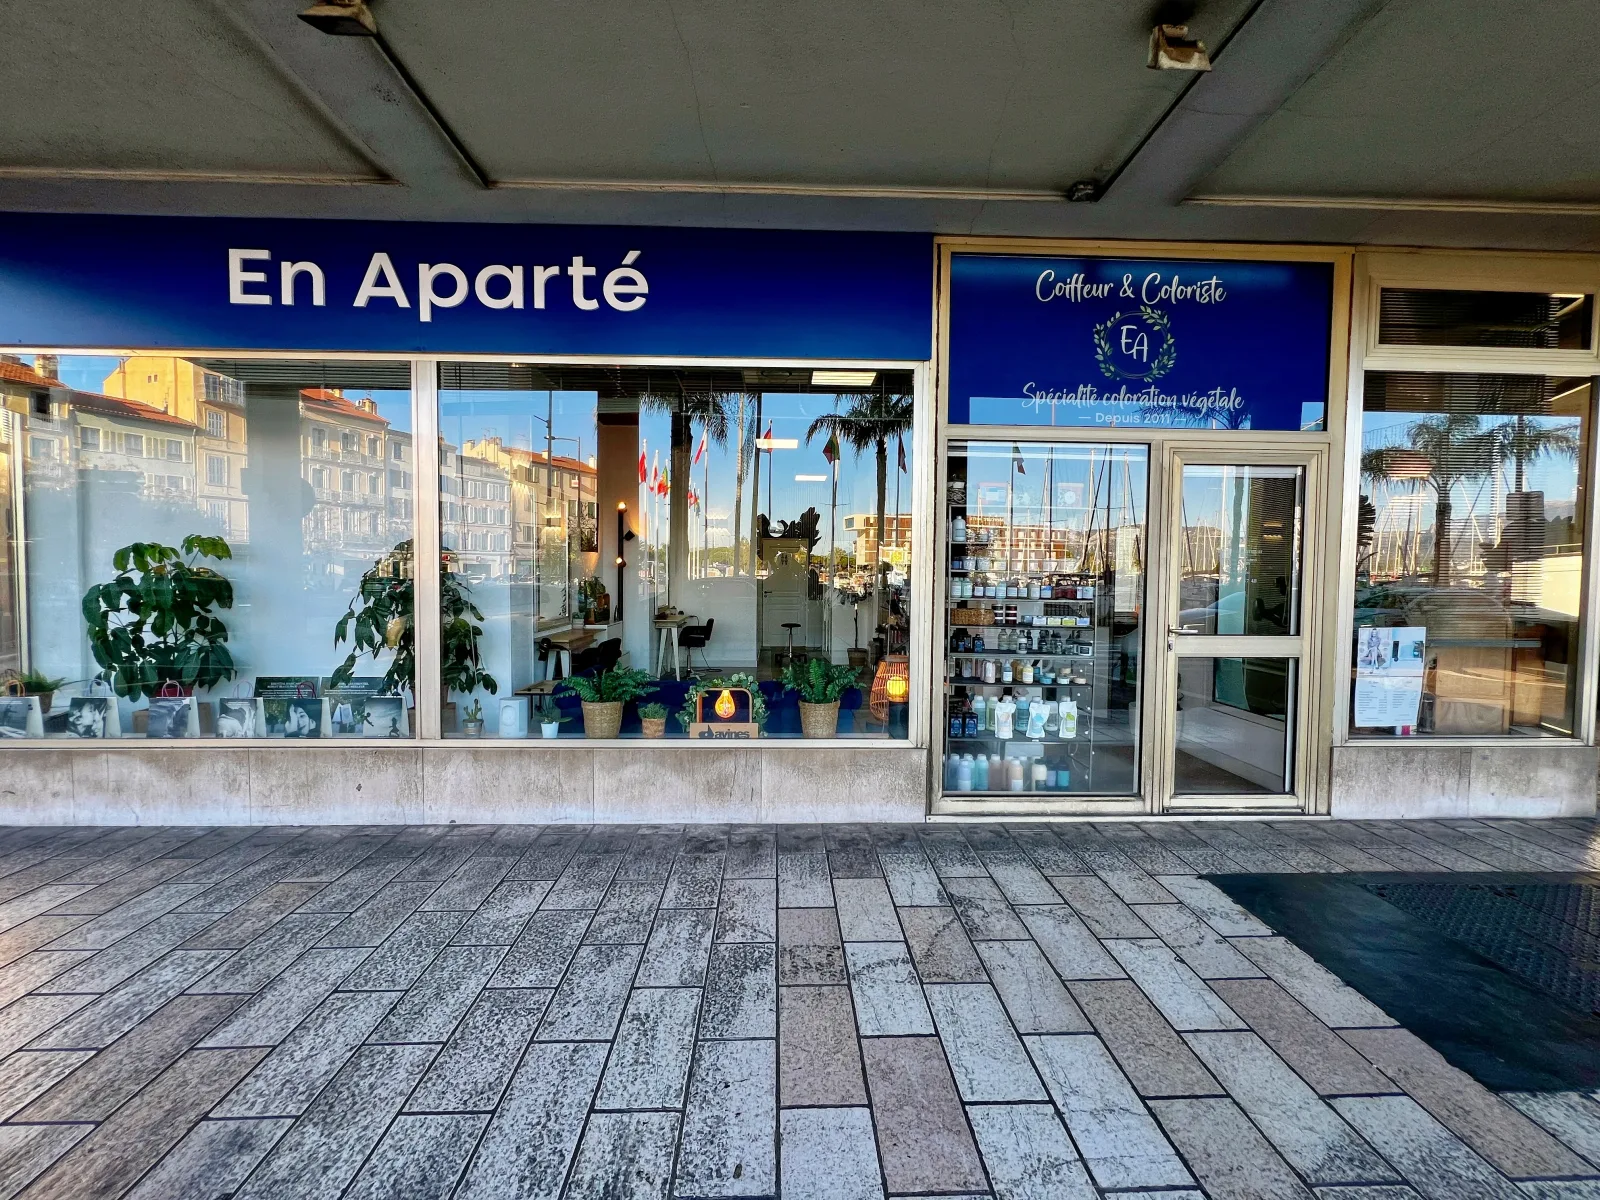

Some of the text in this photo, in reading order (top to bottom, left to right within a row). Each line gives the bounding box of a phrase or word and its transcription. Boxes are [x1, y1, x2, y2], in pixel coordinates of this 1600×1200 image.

[229, 248, 649, 322] En Aparté
[1035, 269, 1227, 304] Coiffeur & Coloriste
[1120, 325, 1148, 363] EA
[1022, 382, 1244, 418] Spécialité coloration végétale
[1095, 412, 1171, 424] Depuis 2011
[698, 724, 750, 738] davines
